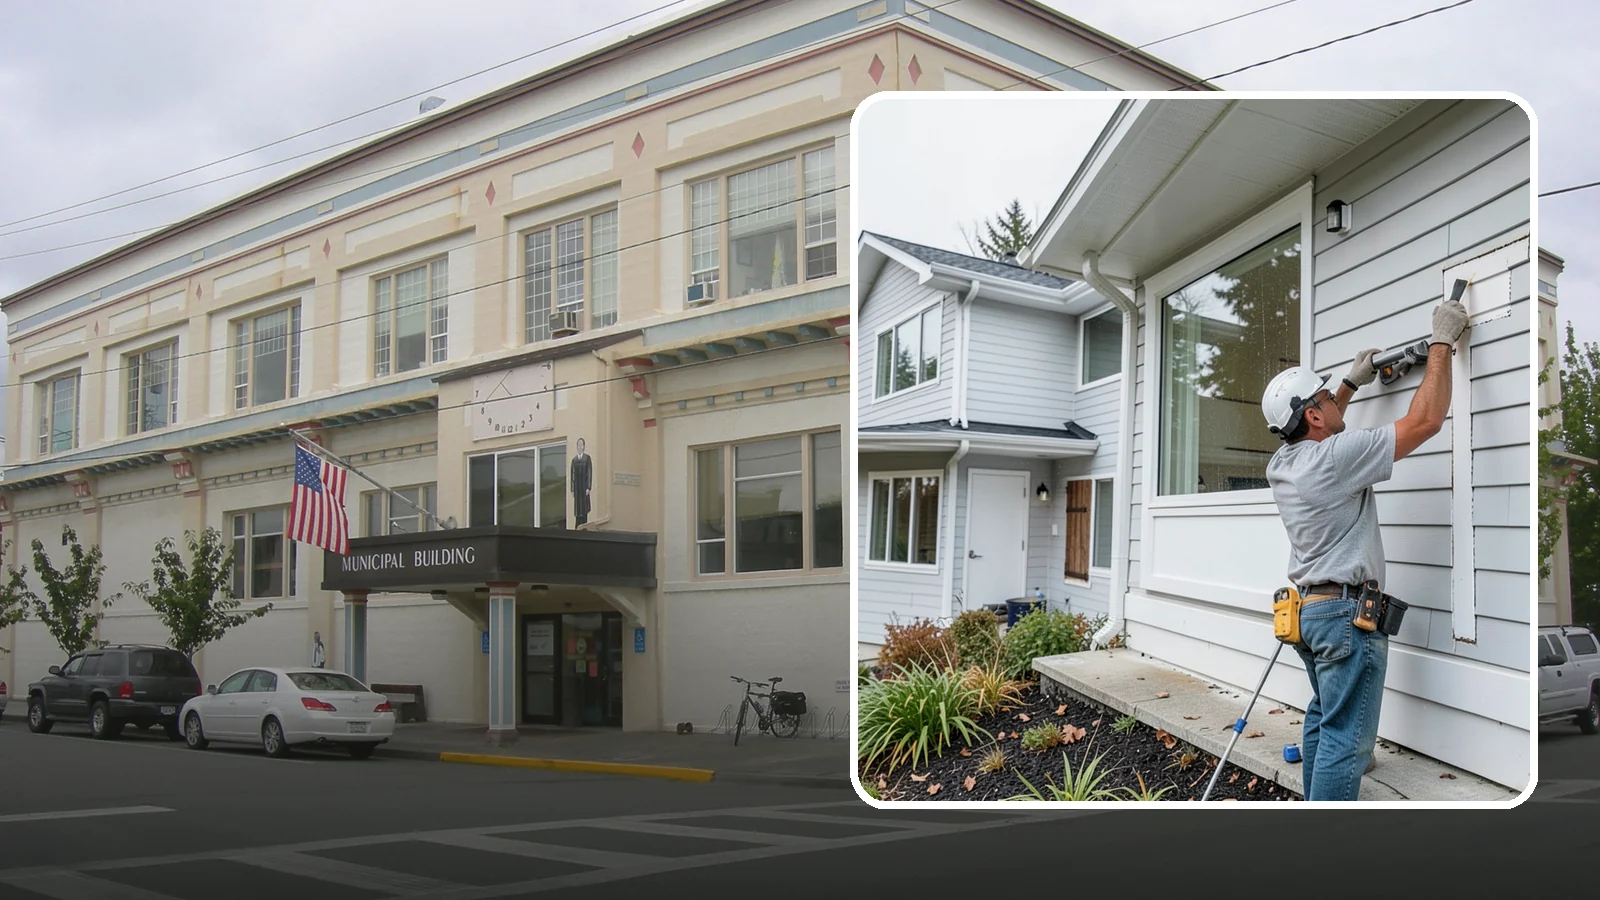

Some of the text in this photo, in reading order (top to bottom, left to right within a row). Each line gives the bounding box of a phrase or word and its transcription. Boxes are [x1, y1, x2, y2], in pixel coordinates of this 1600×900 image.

[547, 362, 551, 370] 6
[476, 390, 479, 398] 7
[536, 402, 540, 410] 4
[481, 407, 485, 415] 8
[488, 417, 492, 425] 9
[529, 414, 533, 422] 3
[521, 420, 525, 428] 2
[502, 425, 506, 433] 11
[508, 425, 513, 433] 12
[342, 546, 475, 571] MUNICIPAL BUILDING
